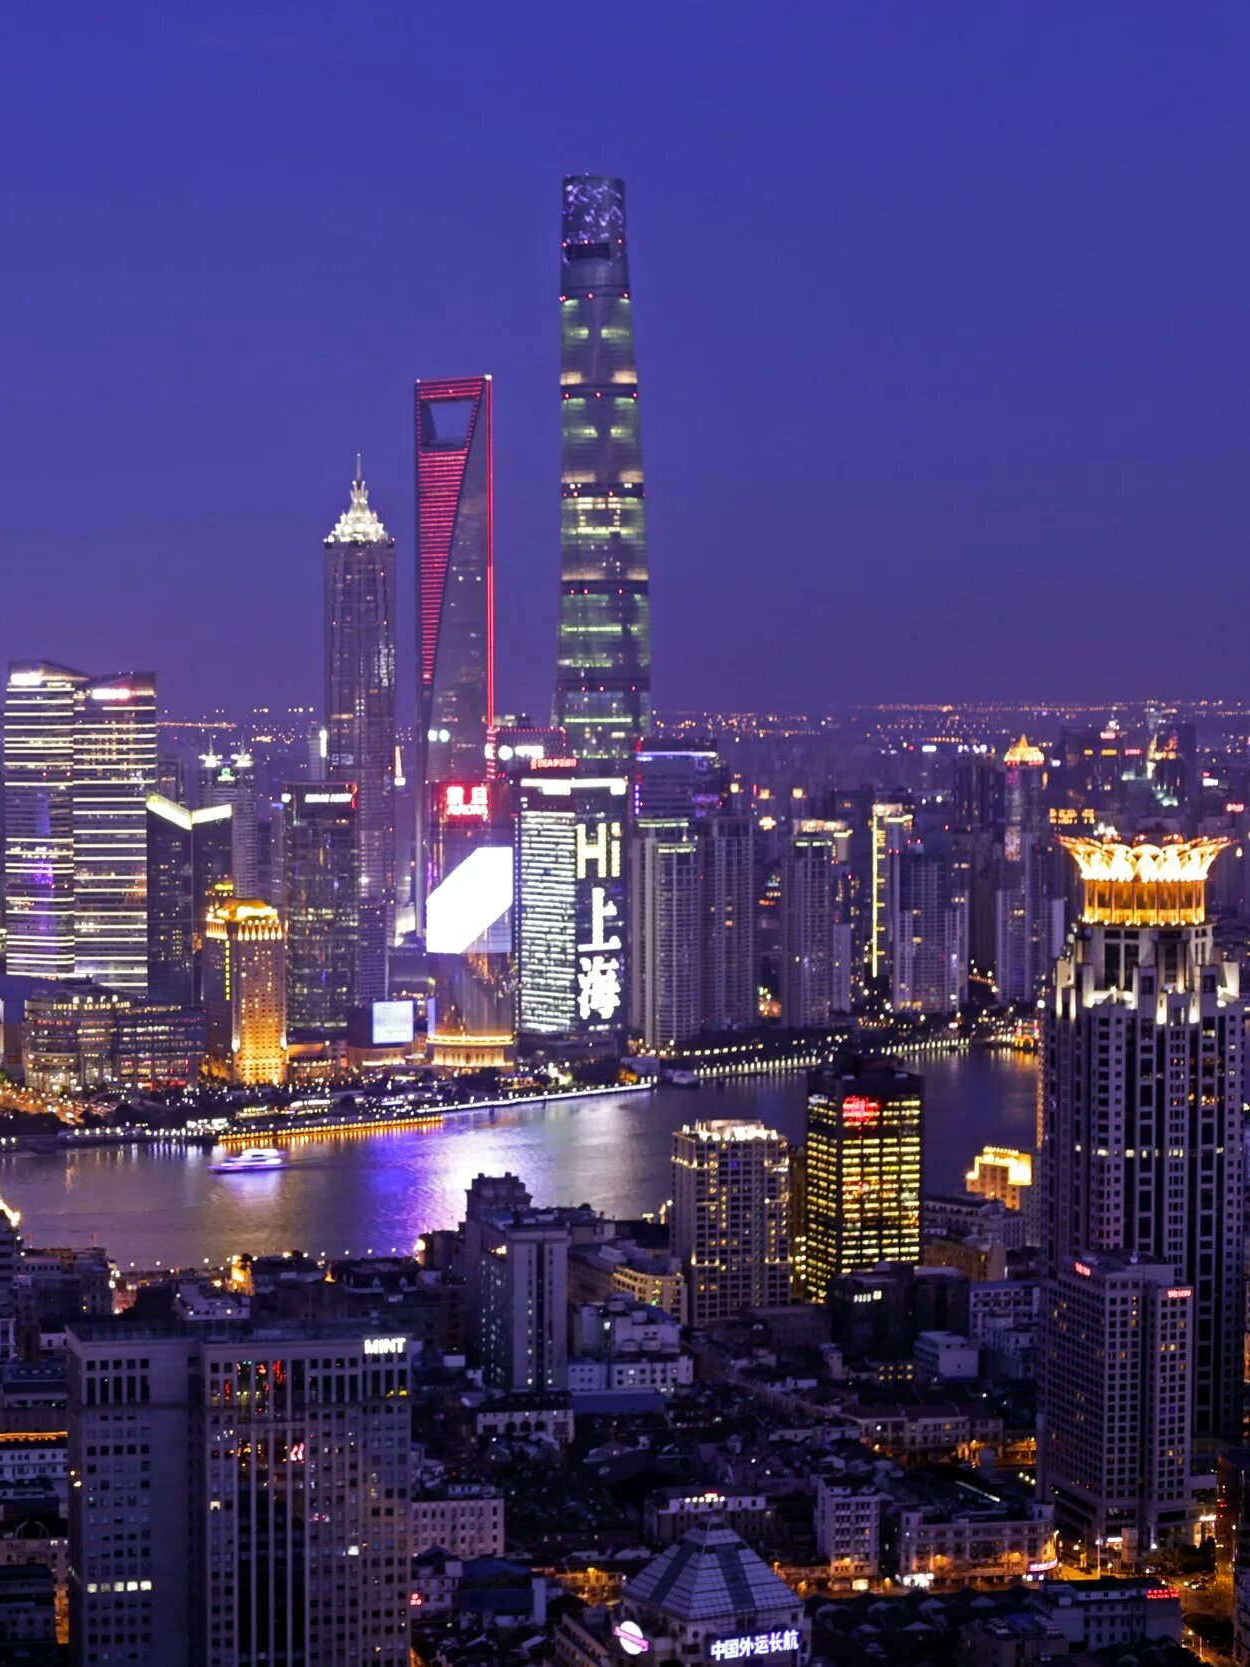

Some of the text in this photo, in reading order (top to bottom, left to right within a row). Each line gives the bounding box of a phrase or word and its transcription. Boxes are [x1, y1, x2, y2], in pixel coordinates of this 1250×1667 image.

[576, 822, 621, 879] Hi
[577, 887, 622, 1020] 上海
[364, 1337, 406, 1355] MINT
[710, 1629, 800, 1661] 中国外运长航
